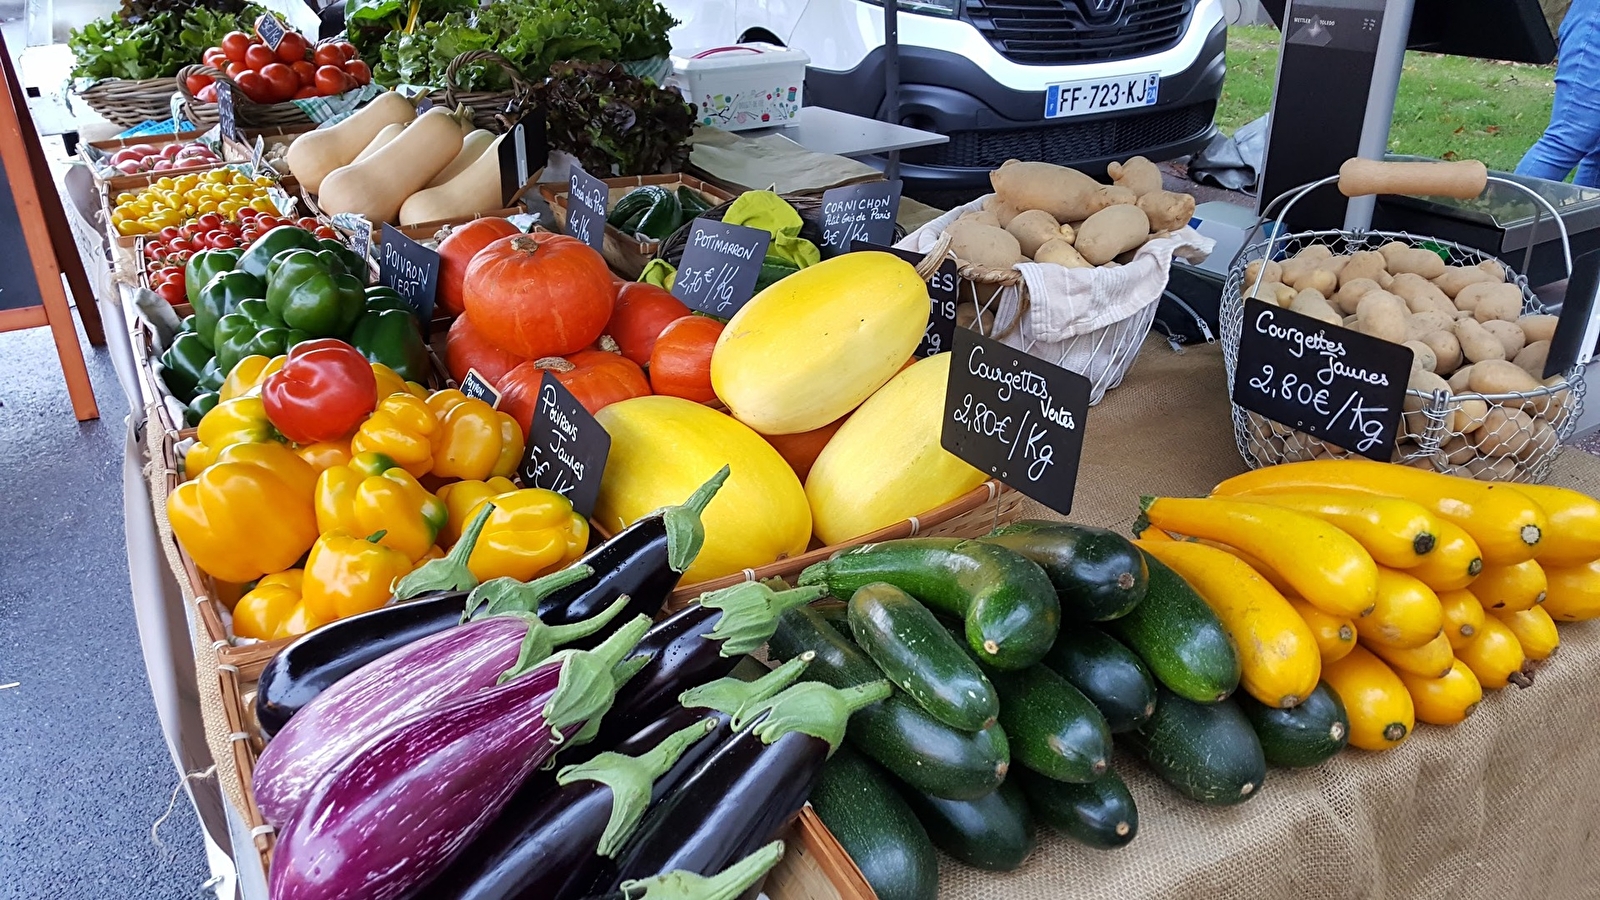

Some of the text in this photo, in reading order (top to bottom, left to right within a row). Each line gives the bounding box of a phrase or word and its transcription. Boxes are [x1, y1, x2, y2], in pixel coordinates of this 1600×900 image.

[1059, 78, 1148, 113] FF-723-KJ
[824, 194, 891, 215] CORNICHON
[855, 212, 867, 222] de
[870, 207, 892, 220] Paris
[693, 229, 759, 260] POTIMARRON
[385, 242, 431, 286] POIVRON
[390, 273, 420, 298] VERT
[1255, 310, 1347, 359] Courgettes
[968, 345, 1049, 402] Courgettes
[1040, 395, 1076, 430] Vertes
